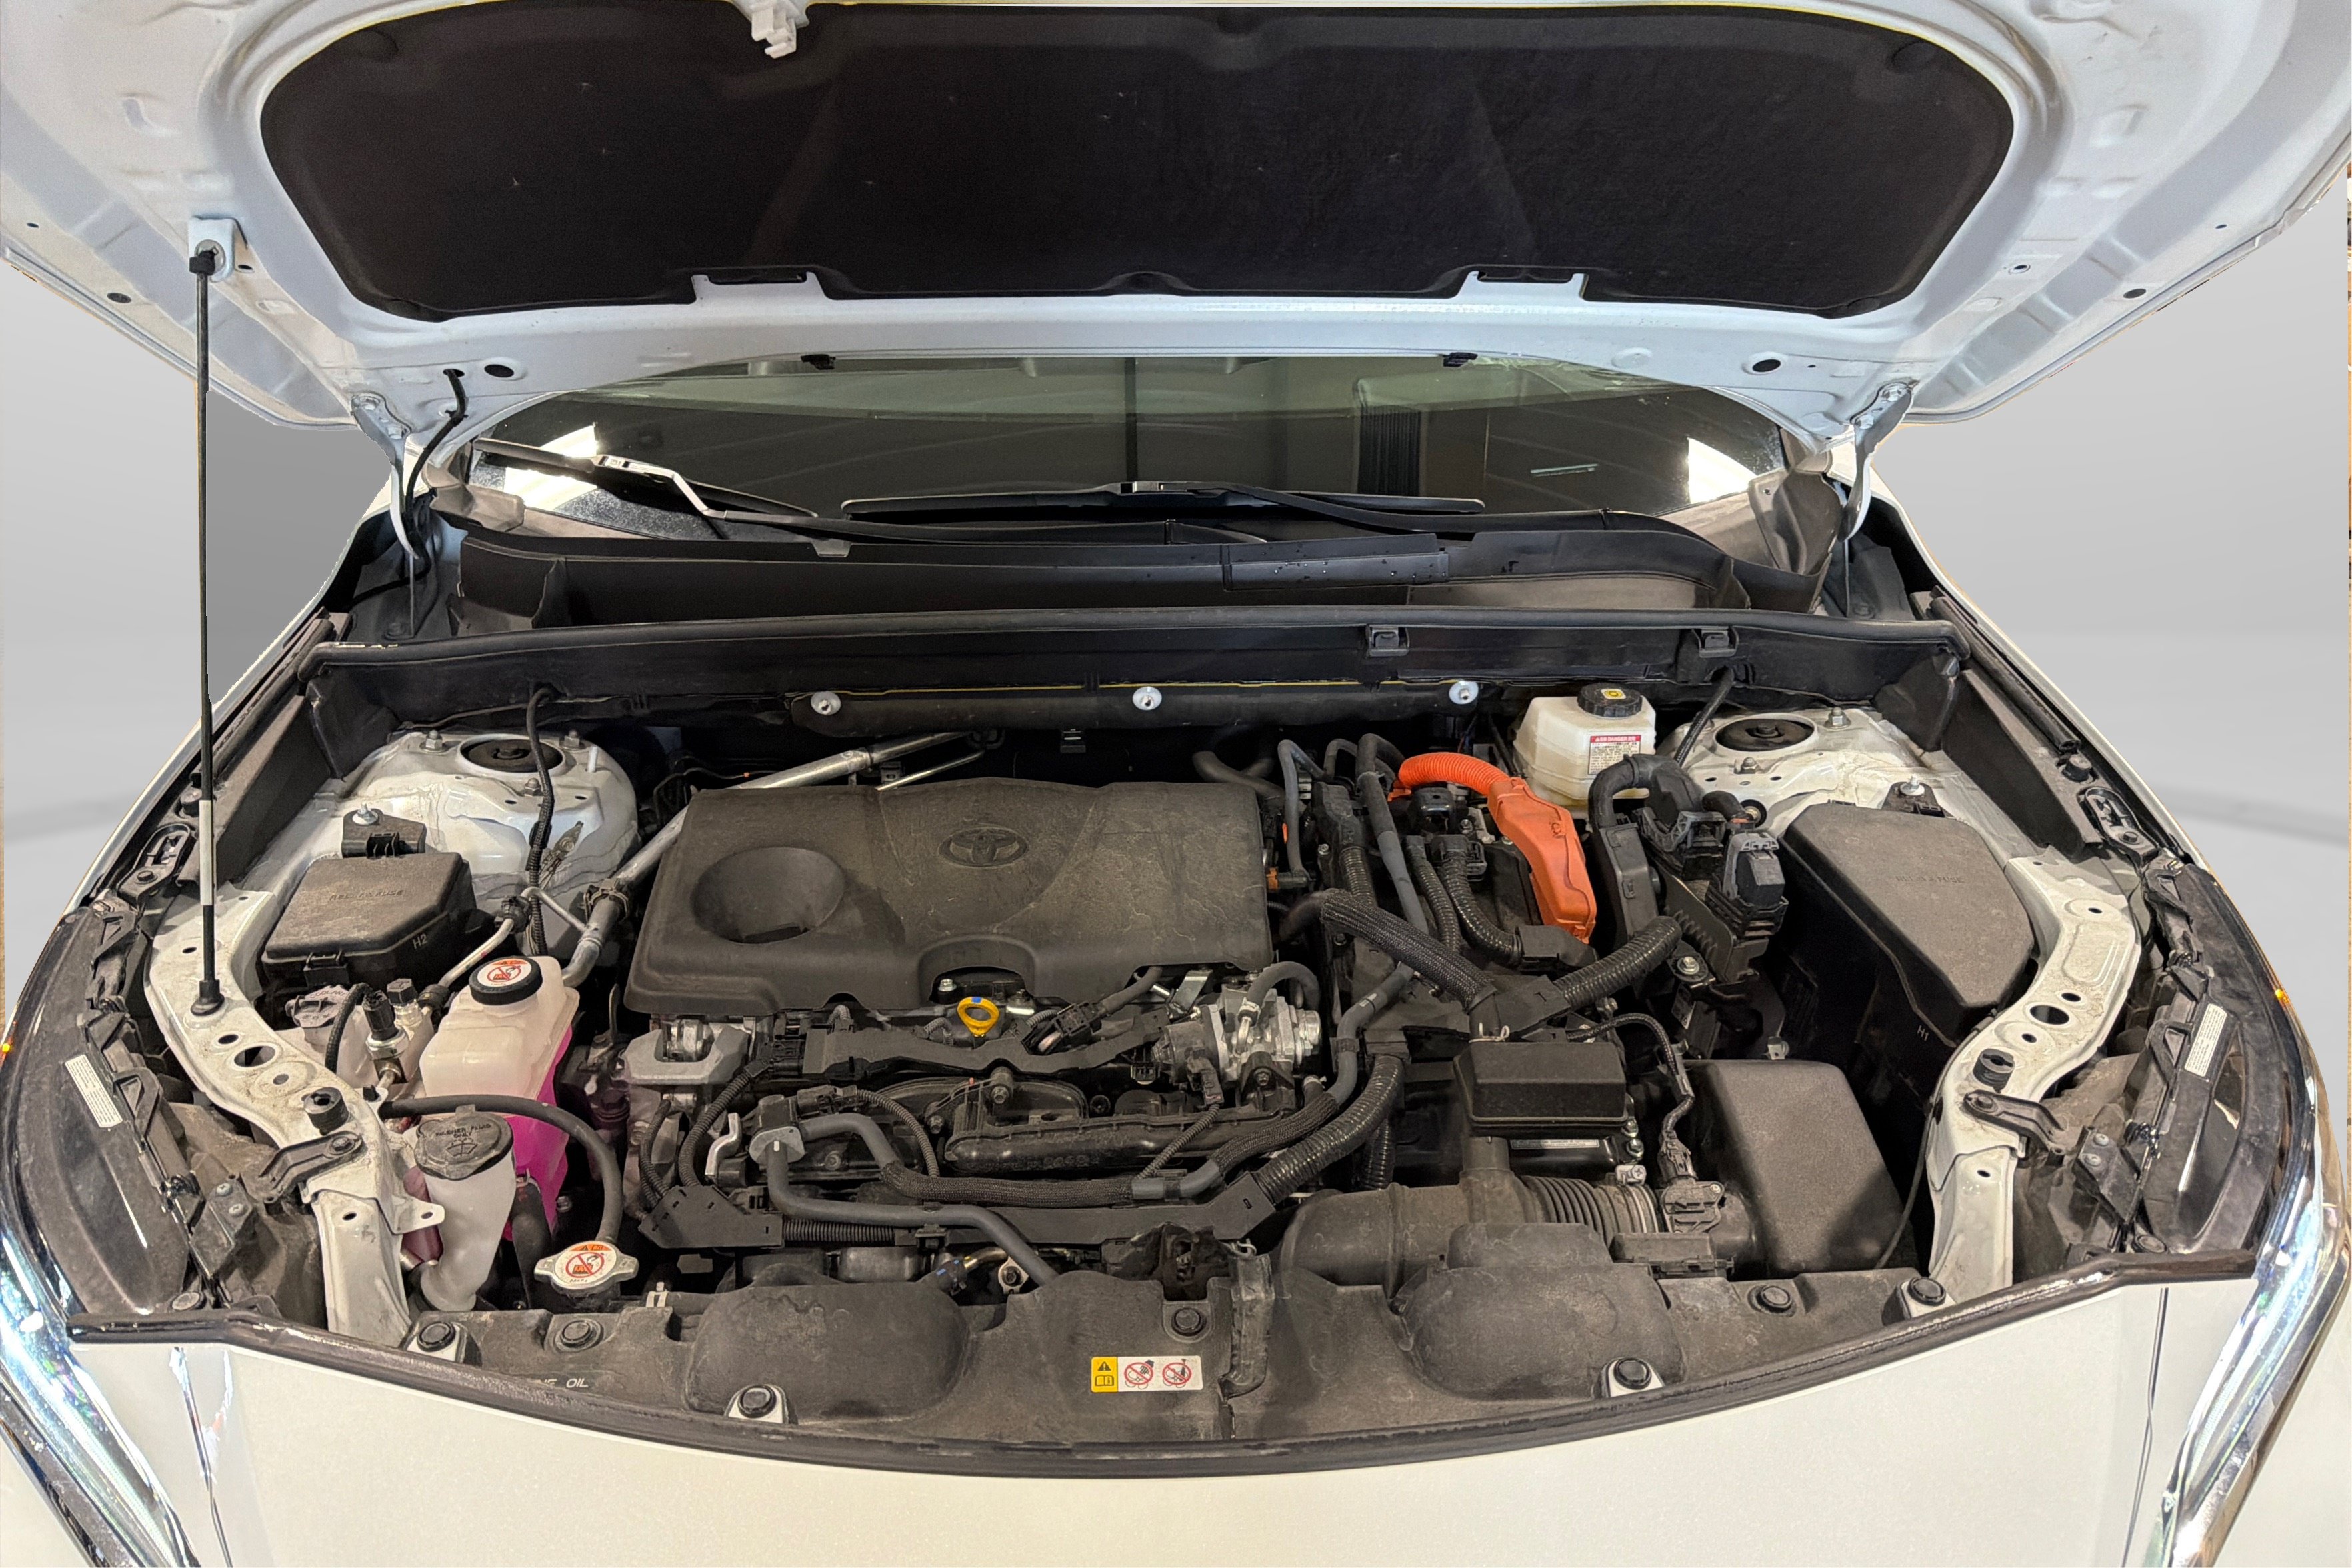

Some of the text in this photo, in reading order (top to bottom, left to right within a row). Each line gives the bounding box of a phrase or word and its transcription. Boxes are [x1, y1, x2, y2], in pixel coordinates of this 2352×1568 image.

[413, 933, 429, 949] H2
[1917, 1025, 1929, 1041] H1
[565, 1377, 589, 1389] OIL
